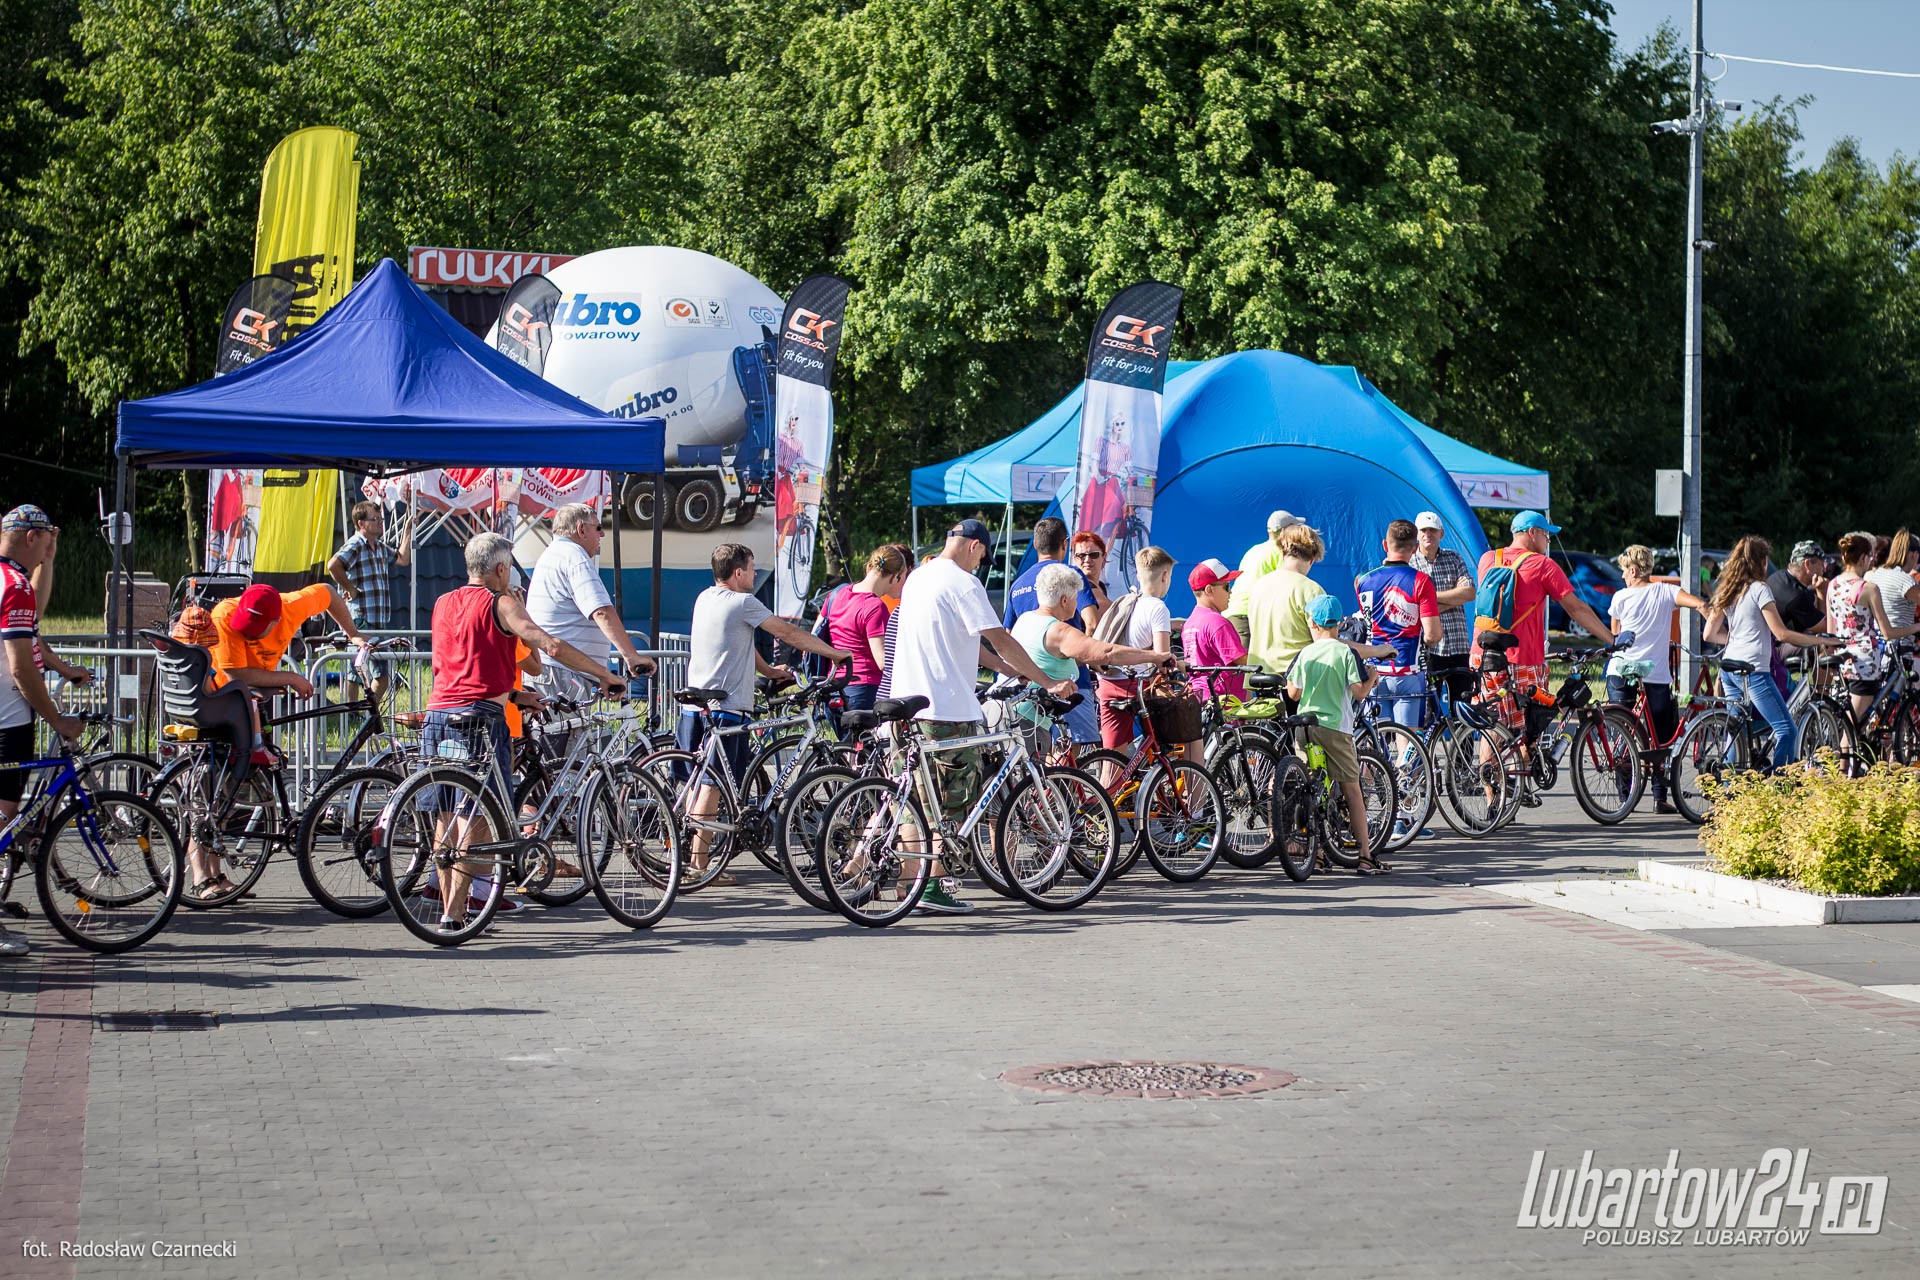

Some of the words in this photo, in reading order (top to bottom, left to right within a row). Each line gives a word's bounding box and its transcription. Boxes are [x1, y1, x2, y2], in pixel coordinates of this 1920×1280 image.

[505, 302, 548, 342] CK
[553, 293, 641, 326] ibro
[232, 307, 278, 342] CK
[562, 330, 641, 342] owarowy
[788, 307, 837, 342] CK
[1105, 314, 1165, 347] CK
[784, 331, 830, 353] COSSACK
[1100, 338, 1160, 358] COSSACK
[229, 349, 242, 361] Fit
[242, 352, 255, 364] for
[783, 349, 796, 361] Fit
[794, 352, 808, 364] for
[804, 359, 824, 369] you
[1101, 356, 1115, 367] Fit
[1115, 358, 1133, 369] for
[1128, 366, 1154, 374] you
[522, 479, 554, 501] TOWIE
[980, 760, 1012, 809] GIANT
[11, 793, 52, 839] MERIDA
